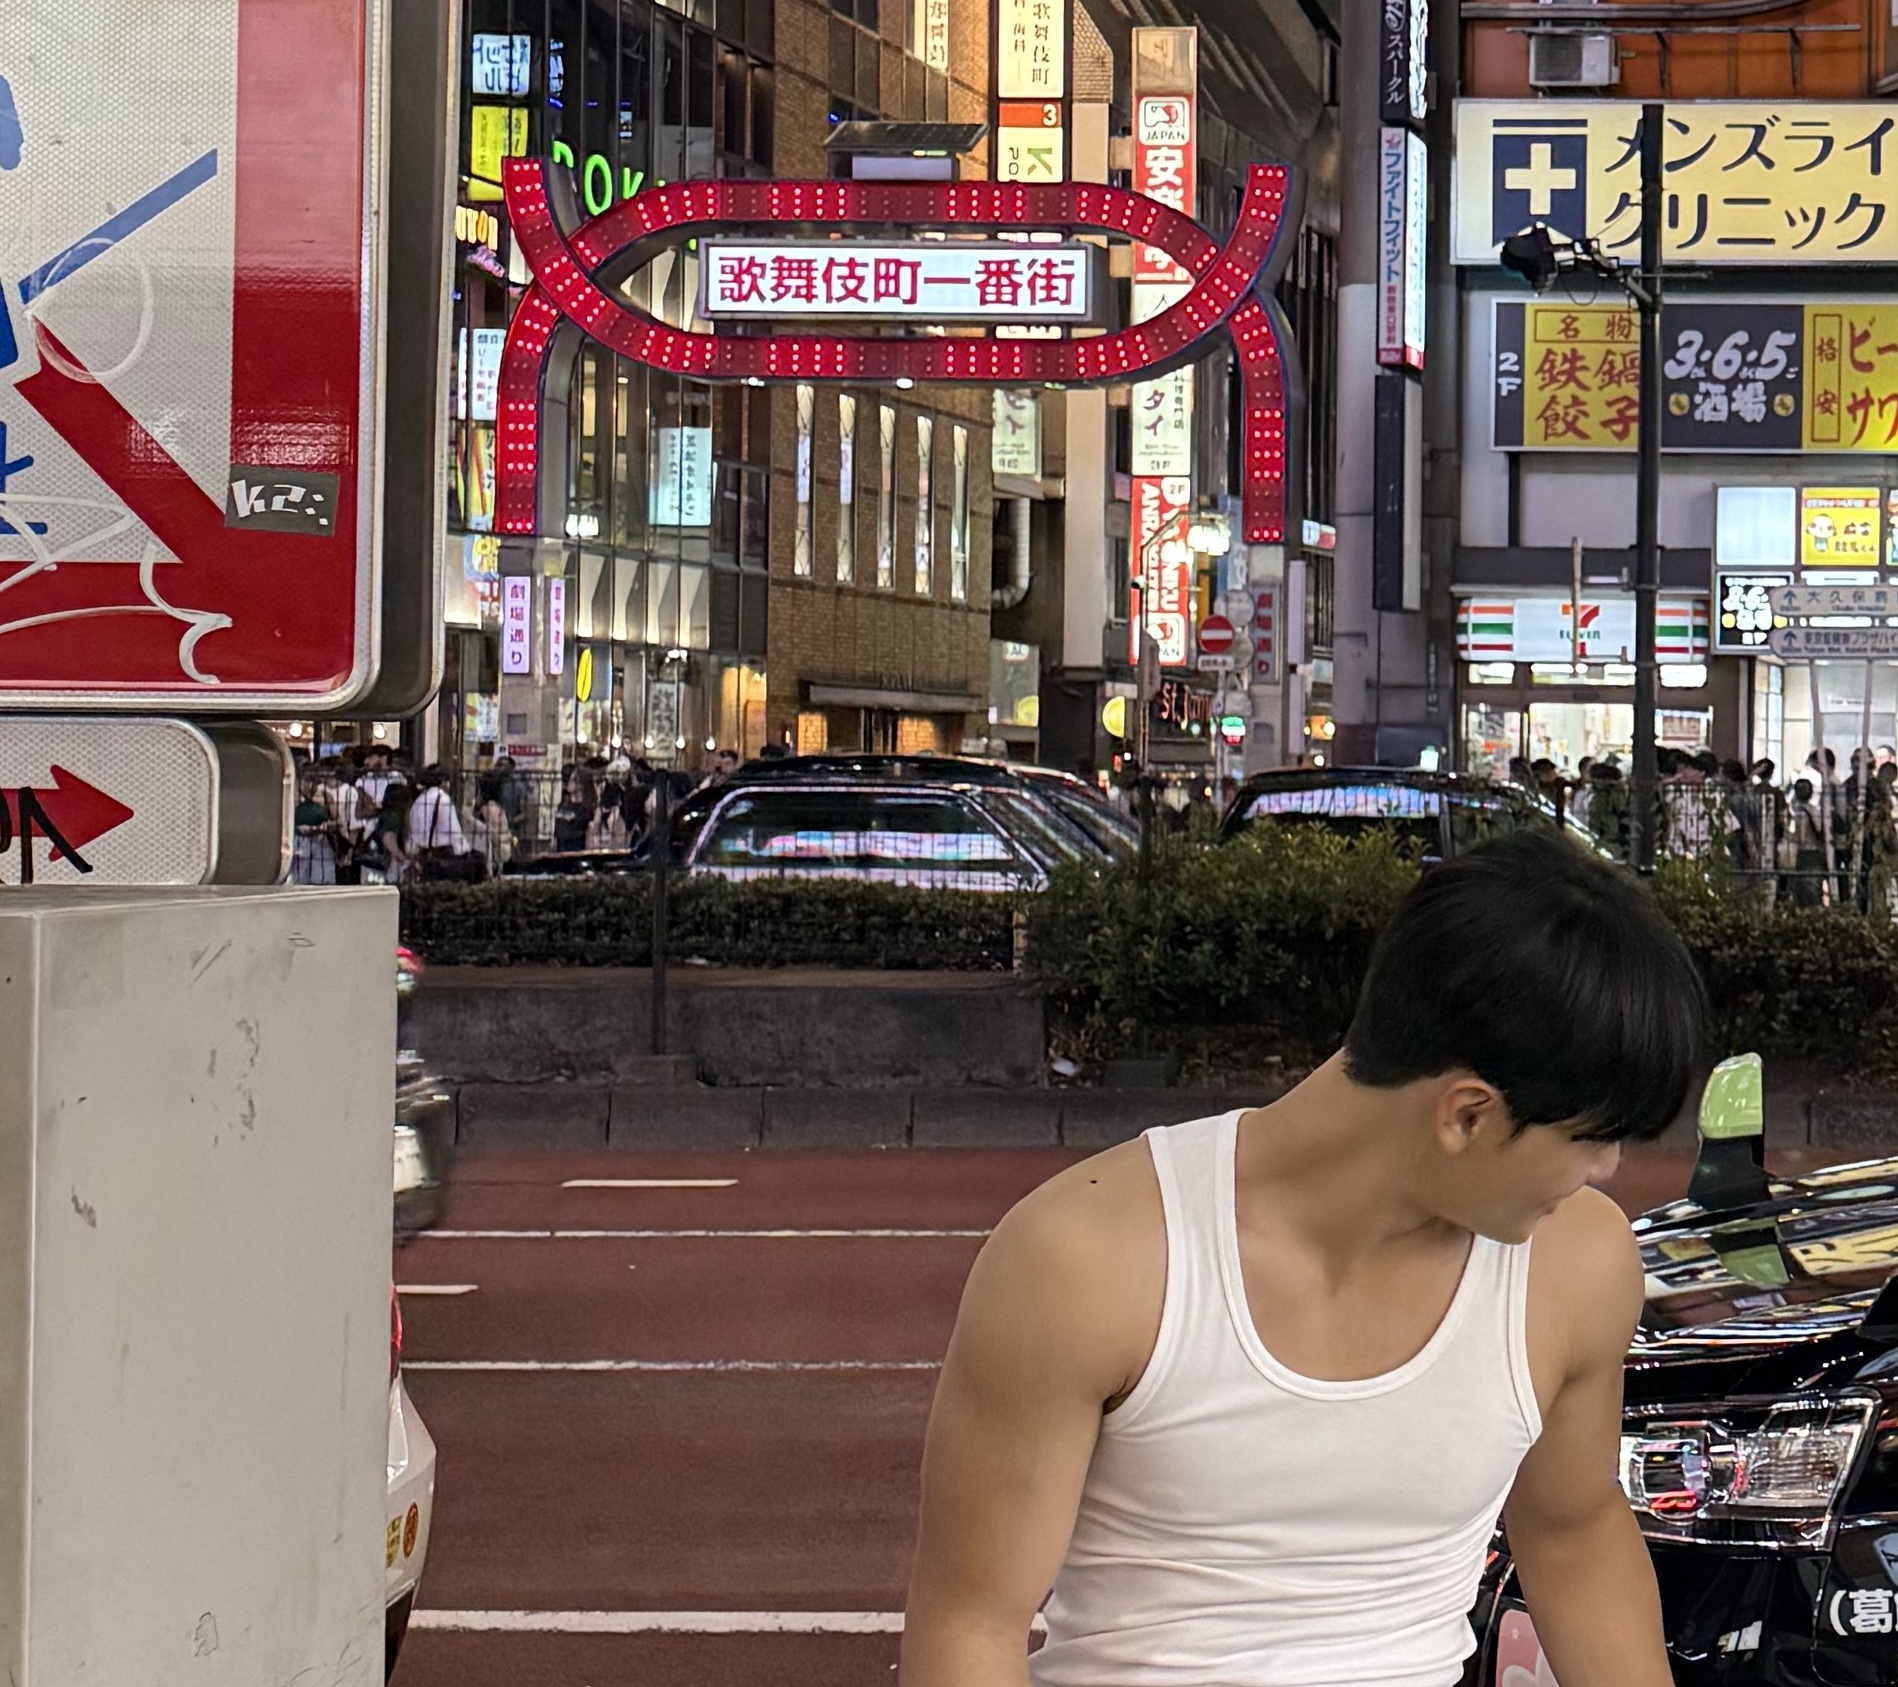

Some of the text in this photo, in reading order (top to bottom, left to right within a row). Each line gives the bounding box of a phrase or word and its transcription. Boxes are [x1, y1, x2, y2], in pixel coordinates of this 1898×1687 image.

[1042, 103, 1057, 125] 3
[1145, 129, 1186, 141] JAPAN
[1384, 151, 1403, 282] ファイトフィット
[1603, 193, 1886, 251] クリニック
[716, 255, 1076, 307] 歌舞伎町一番街
[1556, 313, 1634, 342] 名物
[1497, 351, 1522, 397] 2F
[1535, 348, 1640, 394] 鉄鍋
[1814, 337, 1838, 416] 格安
[1536, 394, 1640, 442] 餃子
[1693, 380, 1768, 424] 酒場
[510, 583, 526, 666] 劇場通り
